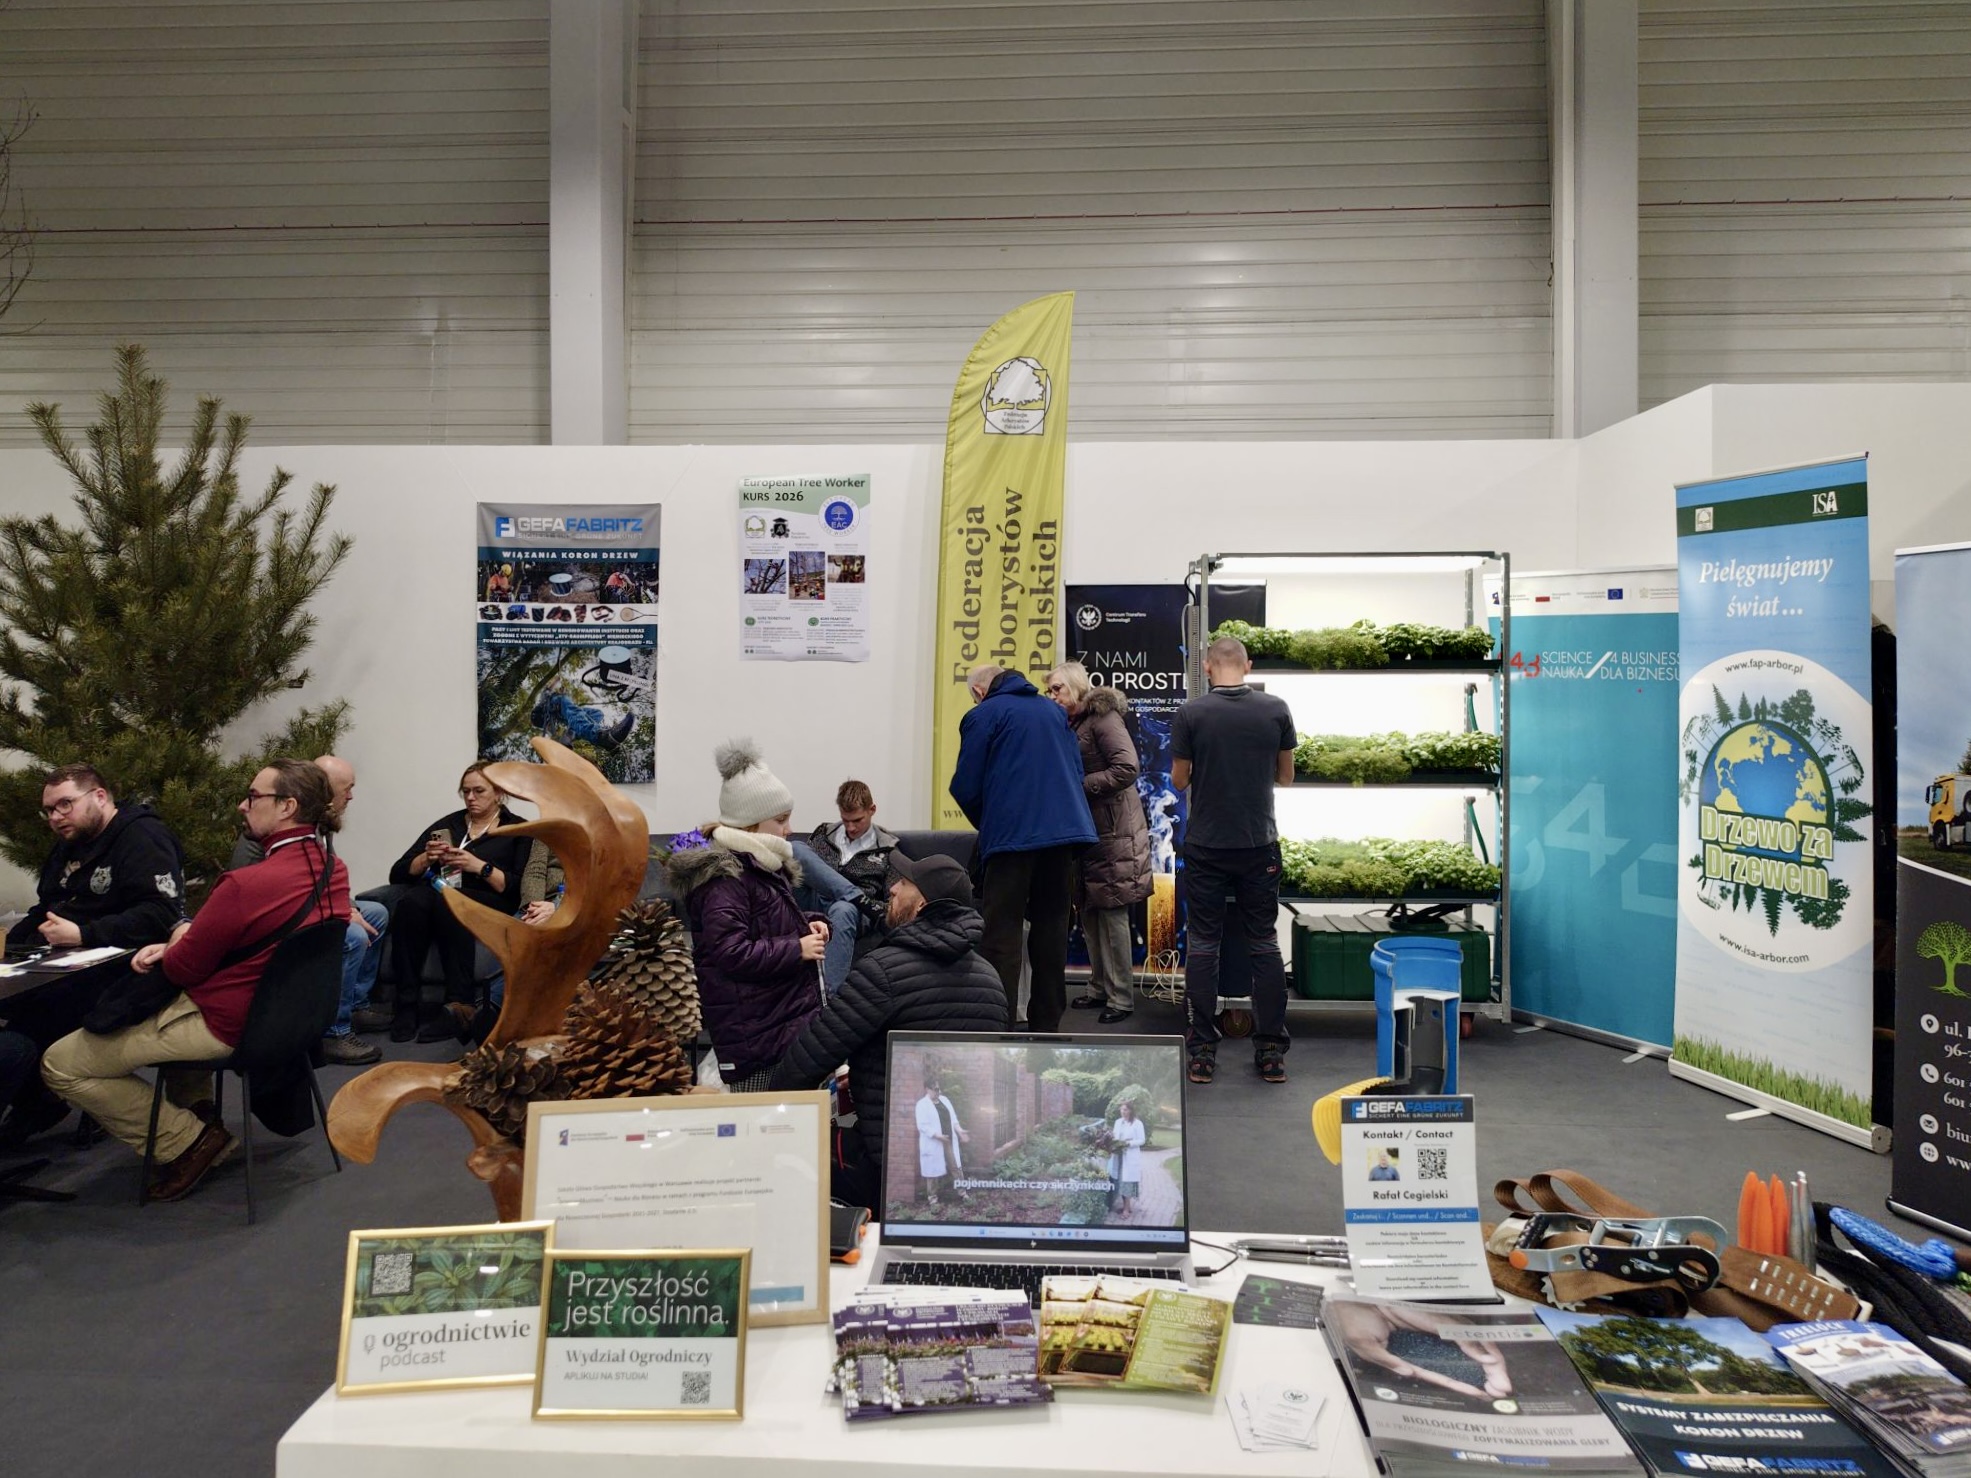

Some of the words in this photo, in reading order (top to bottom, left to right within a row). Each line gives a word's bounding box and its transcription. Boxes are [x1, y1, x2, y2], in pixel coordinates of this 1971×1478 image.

[743, 478, 795, 489] European
[799, 478, 822, 488] Tree
[825, 477, 866, 488] Worker
[743, 492, 770, 501] KURS
[775, 491, 804, 501] 2026
[1812, 491, 1838, 515] ISA
[831, 521, 848, 529] EAC
[502, 551, 557, 561] WIĄZANIA
[562, 551, 599, 559] KORON
[602, 551, 639, 559] DRZEW
[991, 486, 1024, 671] rborystów
[1698, 556, 1834, 588] Pielęgnujemy
[953, 504, 990, 686] Federacja
[1029, 519, 1057, 674] Polskich
[1095, 651, 1147, 668] NAMI
[1542, 651, 1593, 664] SCIENCE
[1542, 666, 1585, 679] NAUKA
[1600, 667, 1623, 680] DLA
[1725, 658, 1804, 675] www.fap-arbor.pl
[1087, 671, 1104, 689] O
[1701, 805, 1797, 854] Drzewo
[1801, 825, 1834, 861] za
[1705, 843, 1829, 901] Drzewem
[1719, 933, 1809, 965] www.isa-arbor.com
[1944, 1021, 1963, 1038] ul.
[1943, 1072, 1965, 1088] 601
[1943, 1092, 1965, 1108] 601
[1363, 1130, 1403, 1139] Kontakt
[1415, 1129, 1453, 1139] Contact
[953, 1177, 1027, 1191] pojemnikach
[1029, 1180, 1049, 1191] czy
[1051, 1179, 1115, 1192] skrzynkach
[1373, 1190, 1400, 1200] Rafał
[1403, 1190, 1448, 1202] Cegielski
[567, 1269, 711, 1302] Przyszłość
[563, 1299, 613, 1331] jest
[621, 1298, 731, 1325] roślinna.
[383, 1319, 531, 1353] ogrodnictwie
[1777, 1320, 1848, 1340] TREELOCK
[380, 1348, 447, 1374] podcast
[565, 1348, 627, 1366] Wydział
[629, 1348, 713, 1367] Ogrodniczy
[564, 1371, 599, 1380] APLIKUJ
[600, 1371, 613, 1380] NA
[1616, 1401, 1687, 1420] SYSTEMY
[1690, 1411, 1837, 1424] ZABEZPIECZANIA
[1402, 1415, 1488, 1433] BIOLOGICZNY
[1491, 1422, 1541, 1436] ZASOBNIK
[1543, 1423, 1574, 1437] WODY
[1672, 1424, 1741, 1438] KORON
[1741, 1428, 1804, 1440] DRZEW
[1473, 1435, 1577, 1446] ZOPTYMALIZOWANIA
